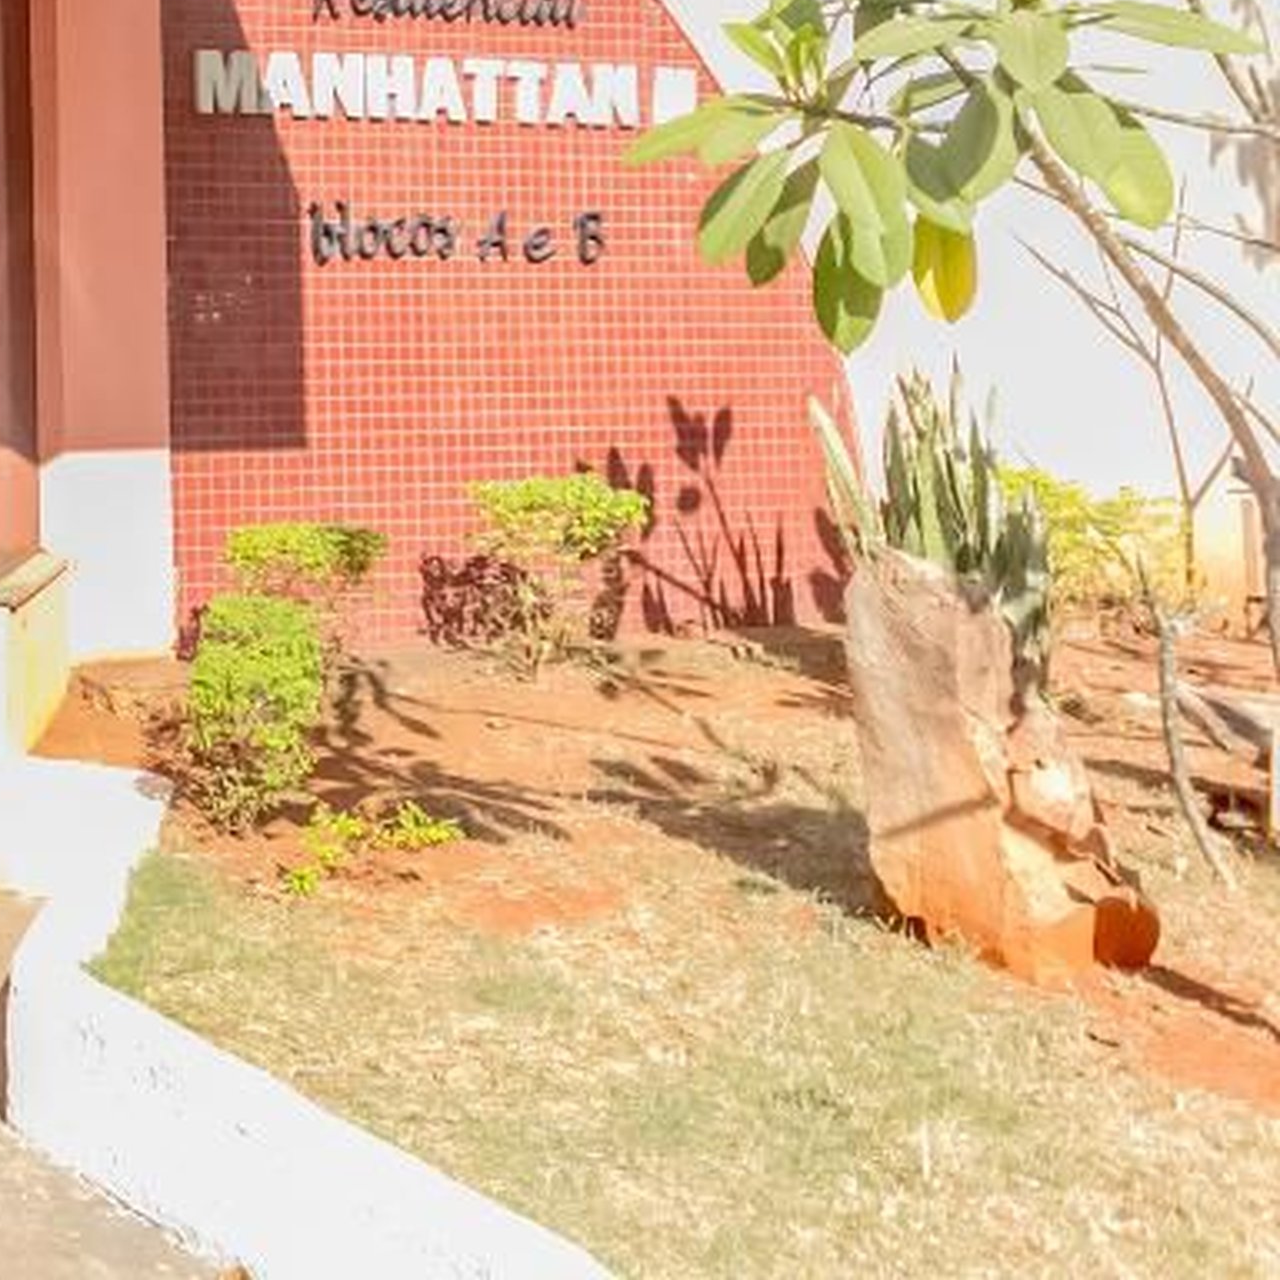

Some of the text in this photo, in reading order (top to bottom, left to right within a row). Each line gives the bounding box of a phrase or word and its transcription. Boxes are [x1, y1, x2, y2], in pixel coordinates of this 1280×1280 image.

[194, 49, 640, 129] MANHATTAN
[307, 201, 606, 267] blocos A e B
